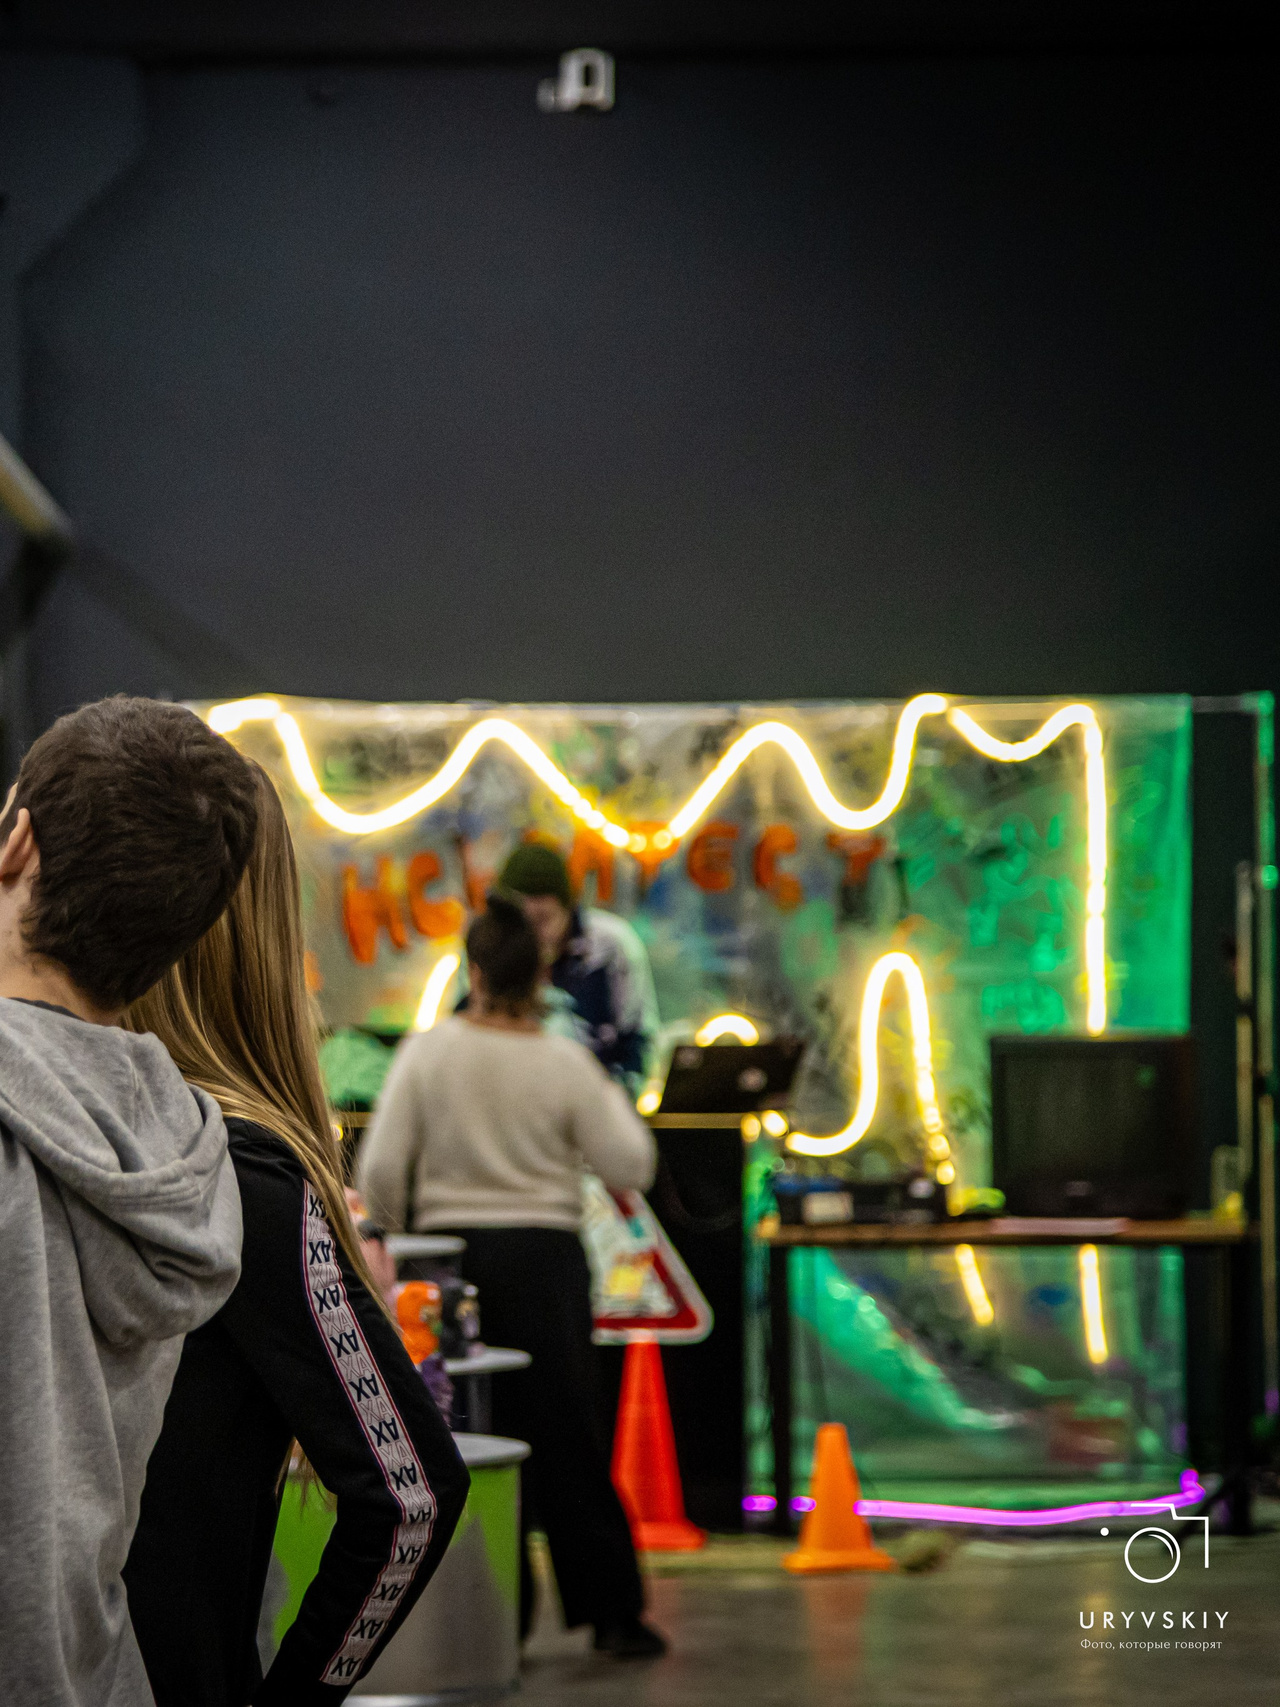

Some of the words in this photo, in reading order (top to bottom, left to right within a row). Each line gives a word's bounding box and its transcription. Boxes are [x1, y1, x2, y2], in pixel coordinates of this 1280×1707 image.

[313, 1285, 340, 1314] AX
[329, 1329, 360, 1358] AX
[349, 1374, 380, 1402] AX
[369, 1417, 400, 1447] AX
[390, 1462, 417, 1491] AX
